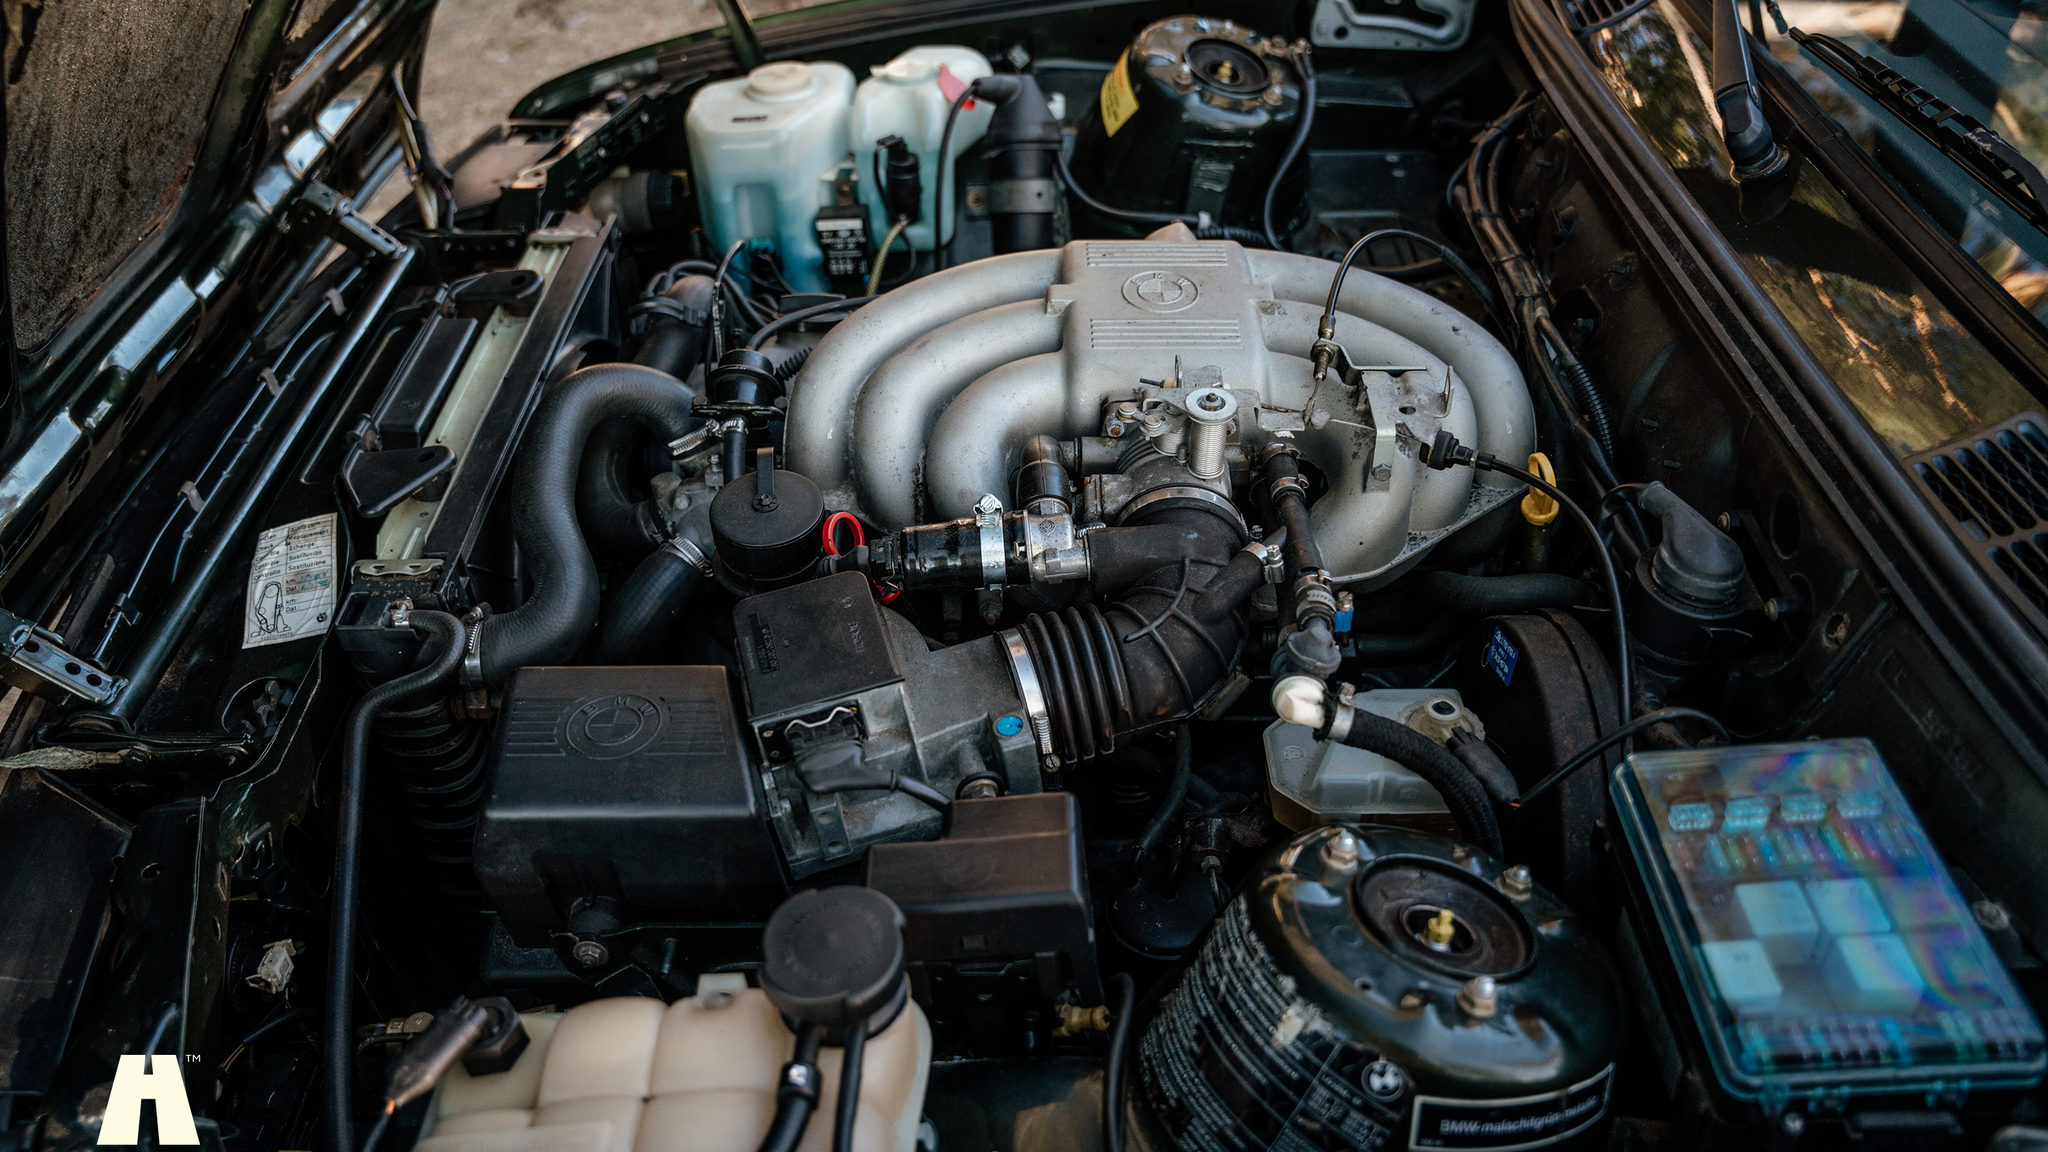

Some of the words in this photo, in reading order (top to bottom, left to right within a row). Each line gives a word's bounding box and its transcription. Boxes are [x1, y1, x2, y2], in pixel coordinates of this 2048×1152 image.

[288, 528, 329, 541] Replacement
[288, 560, 327, 572] Sostituzione
[848, 621, 866, 654] BOSCH
